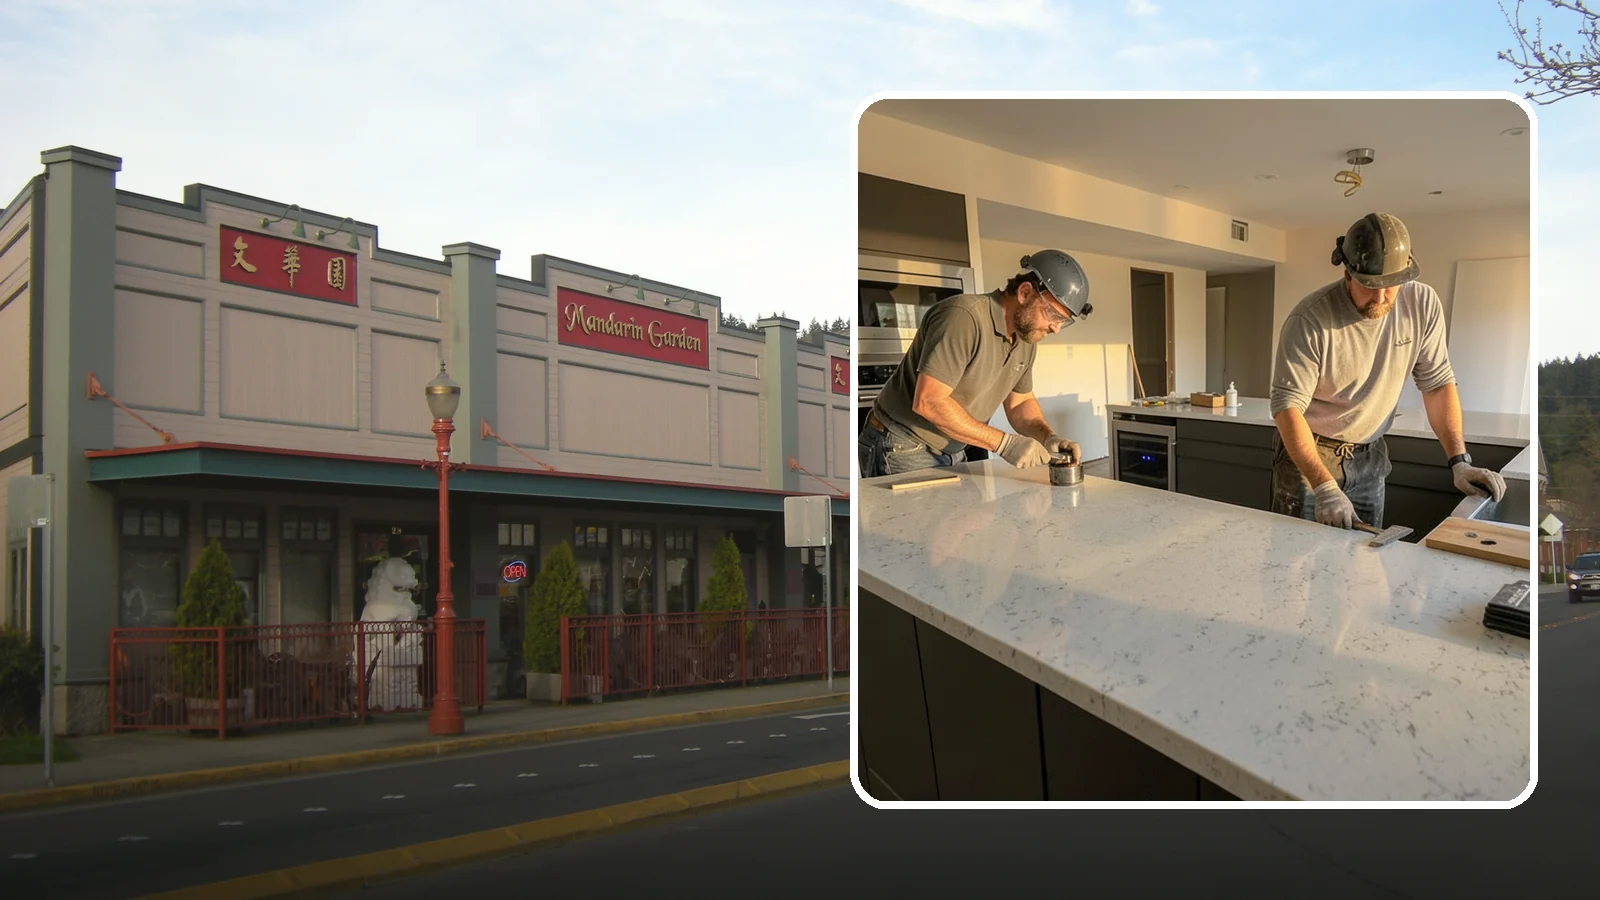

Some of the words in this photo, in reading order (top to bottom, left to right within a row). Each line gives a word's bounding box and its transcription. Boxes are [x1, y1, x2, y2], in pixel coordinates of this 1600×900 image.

[231, 236, 347, 291] 文華園
[565, 302, 644, 341] Mandarin
[648, 320, 701, 352] Garden
[503, 565, 527, 578] OPEN
